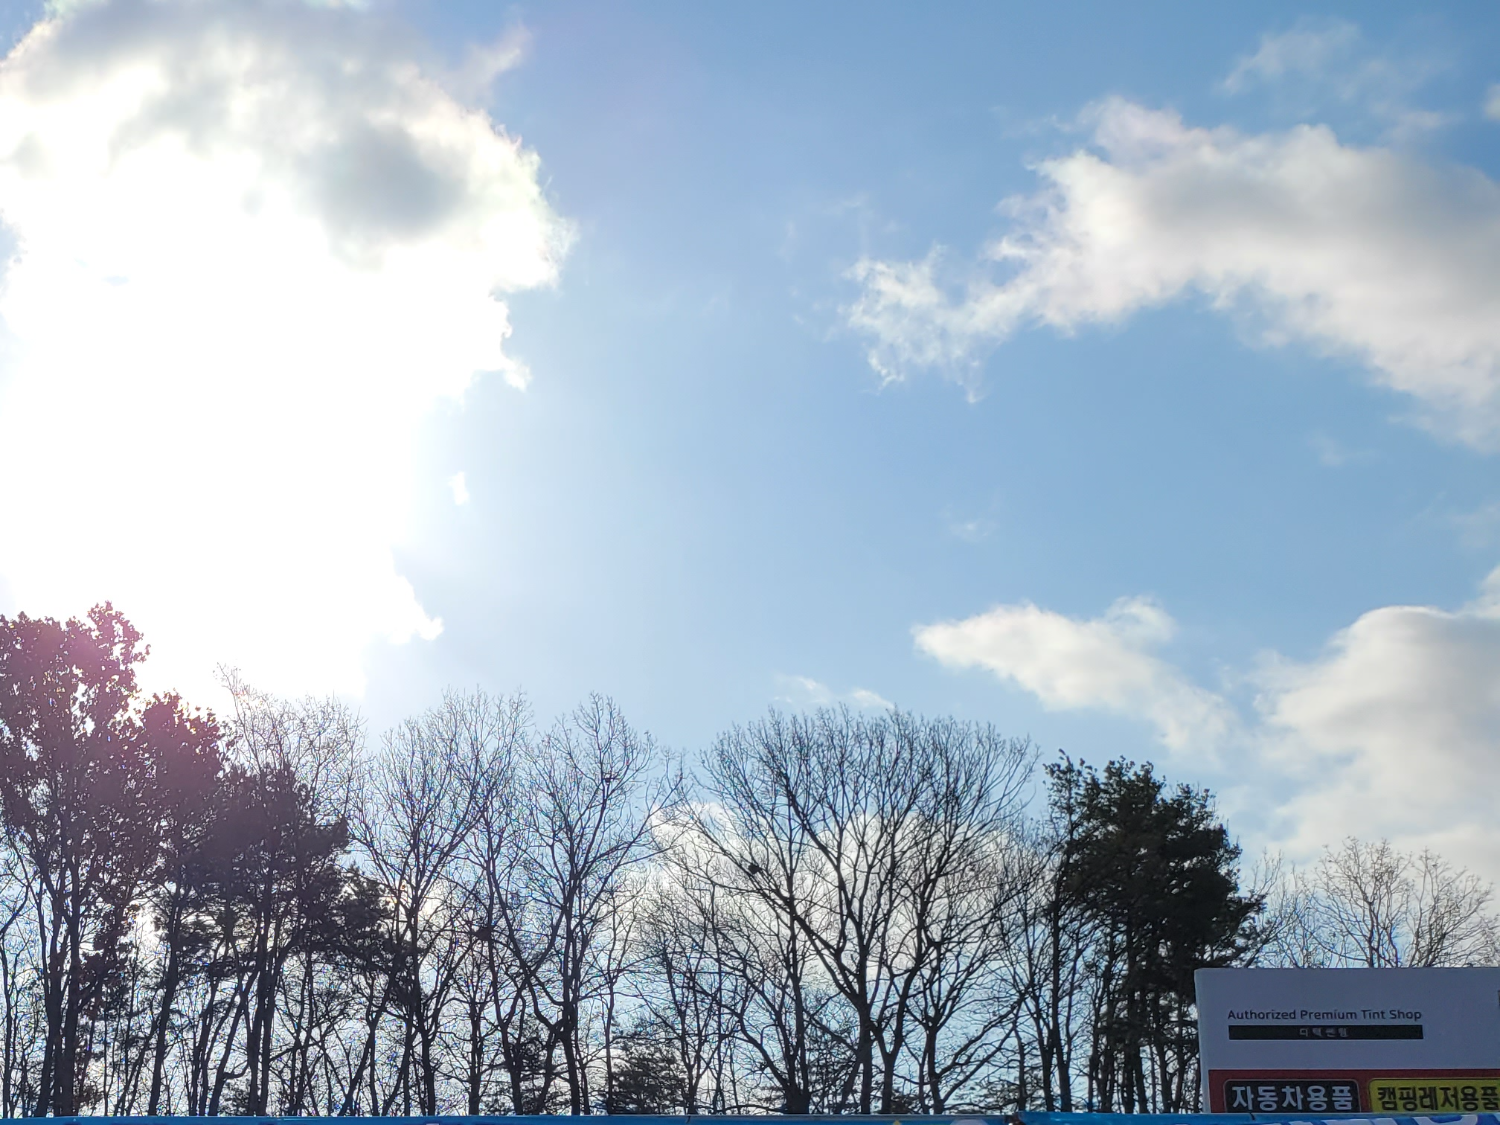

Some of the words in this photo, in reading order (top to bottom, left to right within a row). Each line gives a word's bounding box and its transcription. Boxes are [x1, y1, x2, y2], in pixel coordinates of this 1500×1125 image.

[1228, 1009, 1296, 1020] Authorized
[1300, 1009, 1357, 1020] Premium
[1361, 1009, 1386, 1020] Tint
[1389, 1009, 1422, 1022] Shop
[1231, 1085, 1353, 1112] 자동차용품
[1377, 1086, 1500, 1112] 캠핑레저용품
